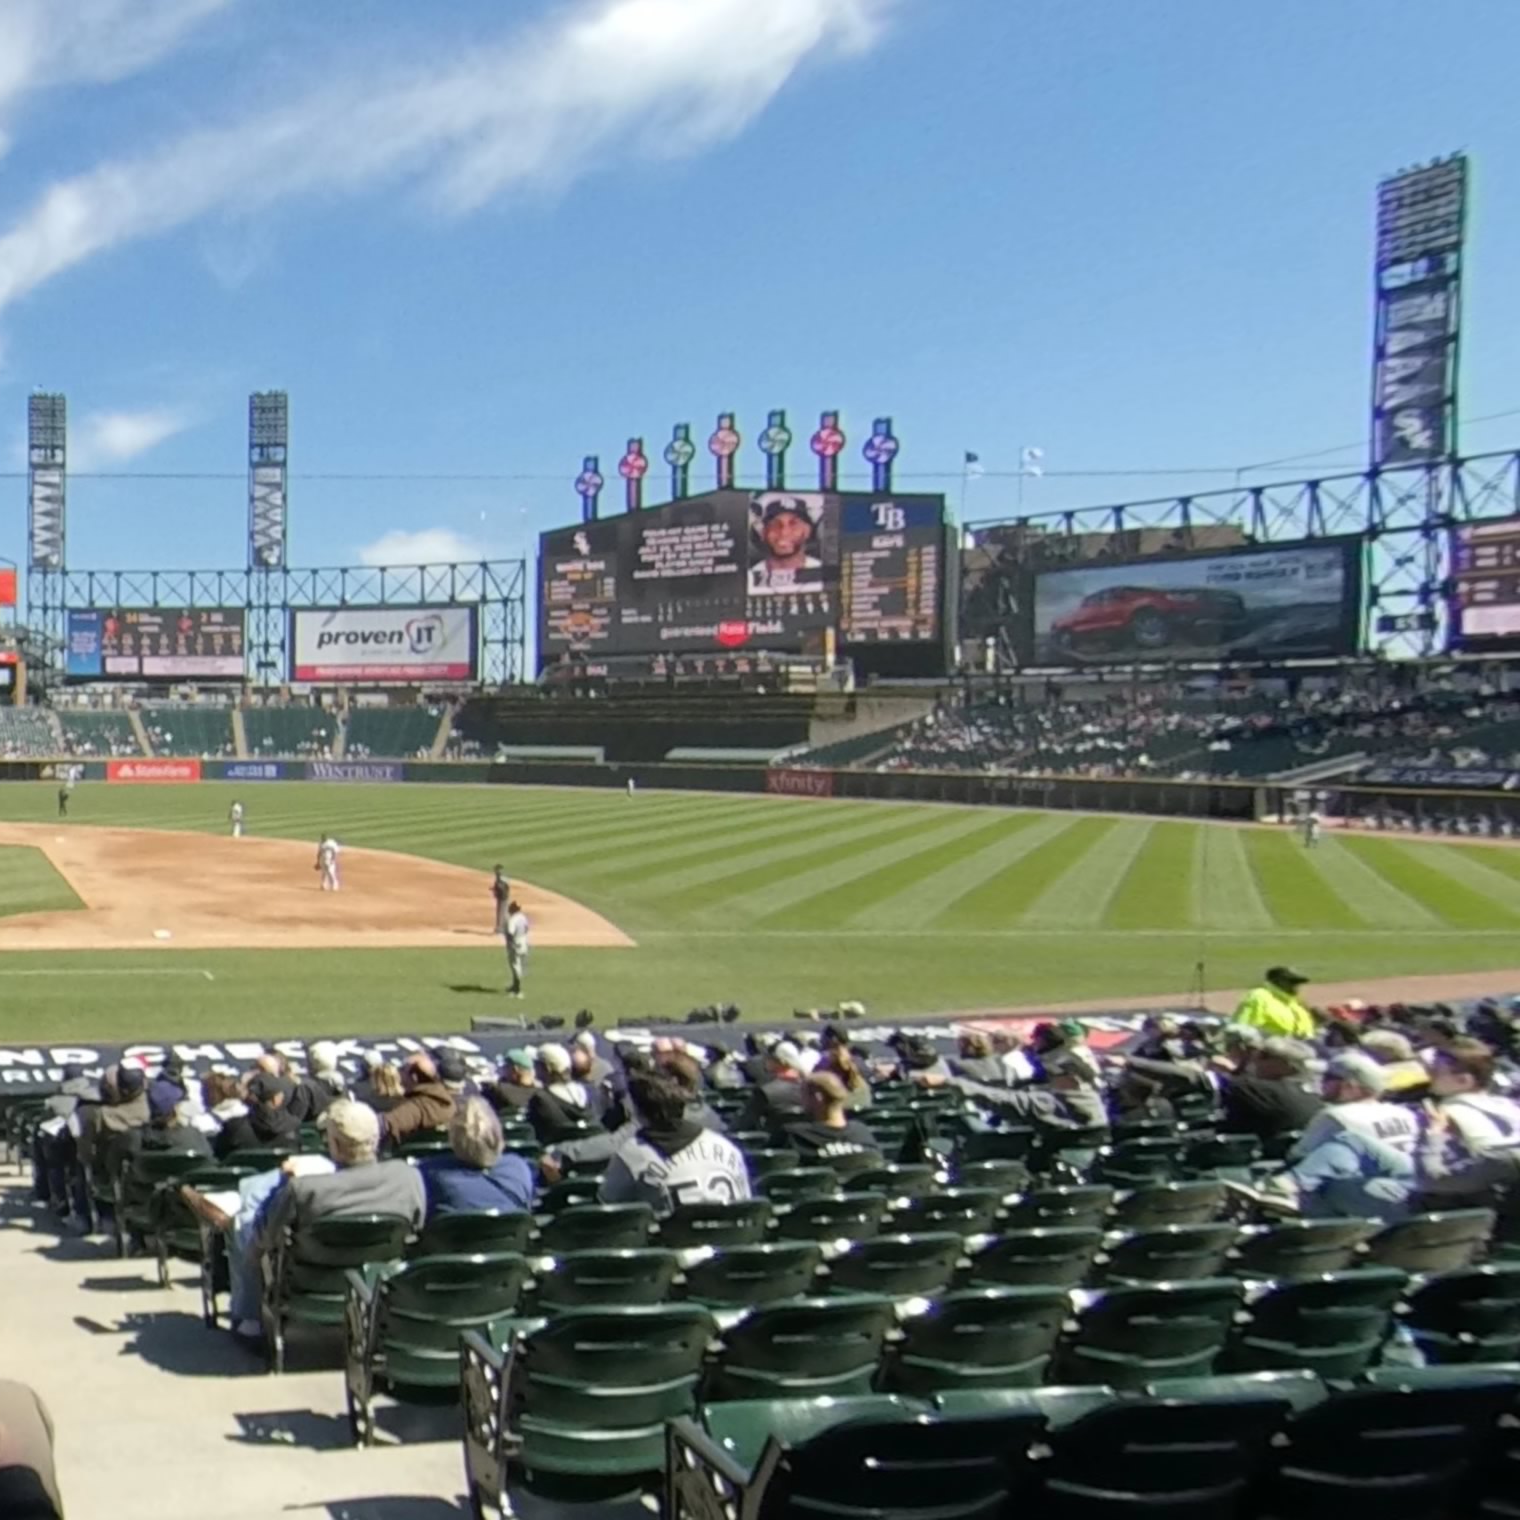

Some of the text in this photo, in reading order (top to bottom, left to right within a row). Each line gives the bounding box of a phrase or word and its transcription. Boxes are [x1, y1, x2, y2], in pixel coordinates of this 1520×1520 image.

[870, 502, 906, 531] TB
[317, 626, 436, 650] proven IT
[313, 762, 394, 780] WINTRUST
[768, 773, 827, 793] xfinity
